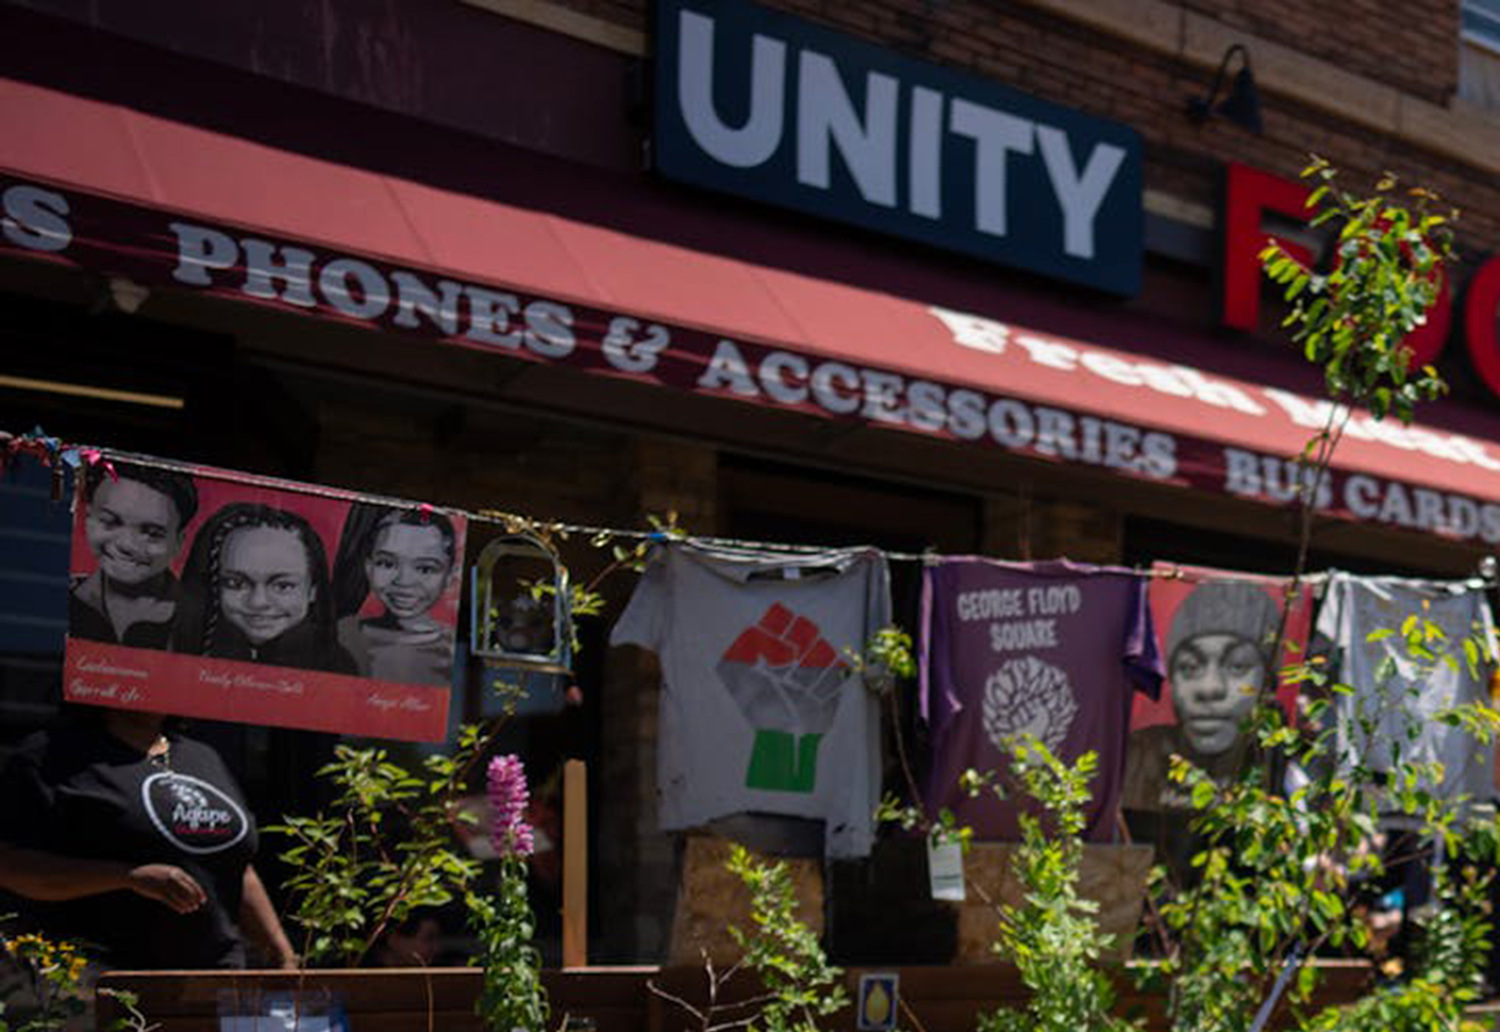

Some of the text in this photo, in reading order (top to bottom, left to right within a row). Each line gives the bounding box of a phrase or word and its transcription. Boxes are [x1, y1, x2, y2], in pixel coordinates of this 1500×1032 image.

[678, 8, 1127, 260] UNITY
[171, 222, 577, 359] PHONES
[602, 315, 669, 373] &
[699, 339, 1178, 478] ACCESSORIES
[1225, 446, 1333, 510] BUS
[957, 584, 1081, 621] GEORGE FLOYD
[989, 619, 1059, 652] SQUARE
[172, 802, 232, 830] Agape
